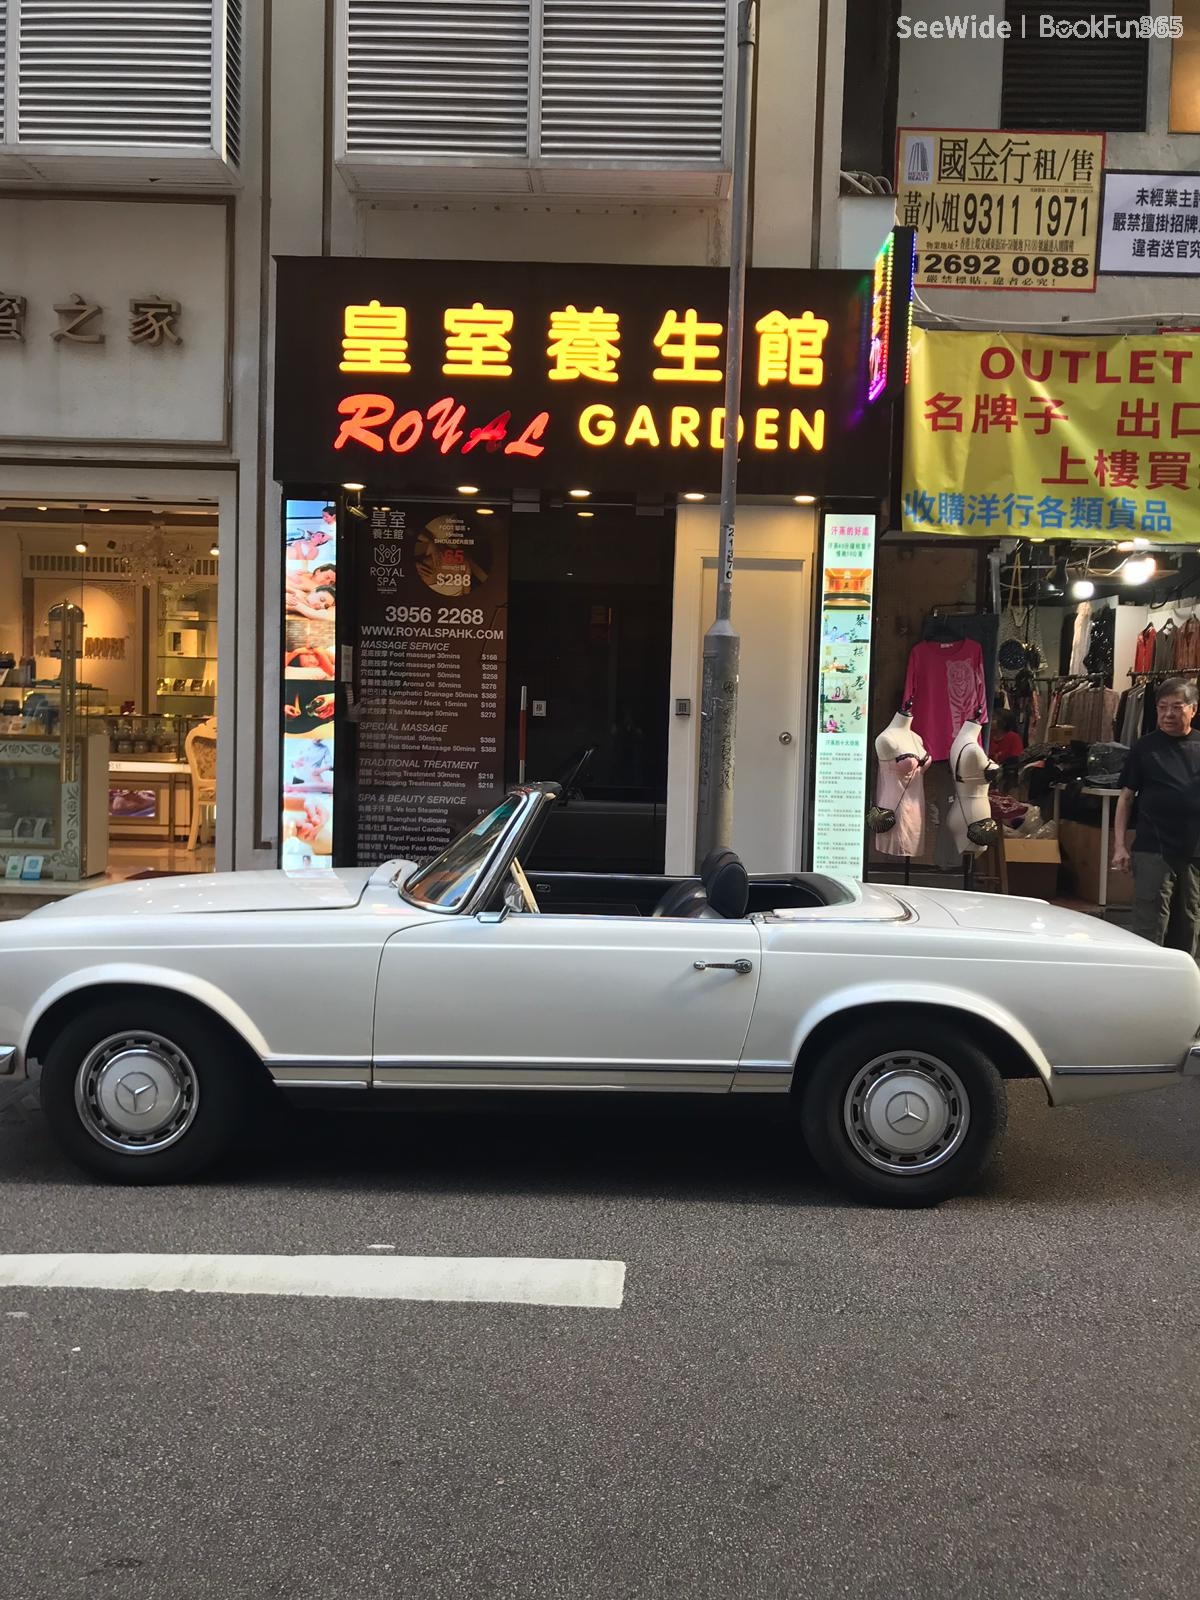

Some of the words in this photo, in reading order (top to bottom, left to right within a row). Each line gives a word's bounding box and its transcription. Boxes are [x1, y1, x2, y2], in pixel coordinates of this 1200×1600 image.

[903, 190, 960, 234] 黃小姐
[963, 192, 1020, 235] 9311
[1034, 195, 1089, 237] 1971
[1112, 212, 1200, 234] 嚴禁擅掛招牌
[1012, 256, 1089, 277] 0088
[338, 299, 830, 387] 皇室養生館
[980, 346, 1193, 384] OUTLET
[924, 392, 1069, 435] 名牌子
[578, 403, 826, 452] GARDEN
[1041, 446, 1200, 491] 上樓買
[904, 489, 1172, 532] 收購洋行各類貨品
[370, 510, 406, 528] 皇室
[369, 567, 405, 577] ROYAL
[377, 577, 397, 587] SPA
[436, 573, 471, 587] $288
[385, 606, 432, 623] 3956
[437, 608, 484, 625] 2268
[361, 626, 504, 640] WWW.ROYALSPAHK.COM
[360, 641, 408, 650] MASSAGE
[410, 642, 450, 651] SERVICE
[406, 652, 436, 660] massage
[437, 652, 460, 660] 30mins
[406, 662, 436, 670] massage
[389, 670, 430, 678] Acupressure
[402, 680, 424, 688] Aroma
[404, 709, 434, 717] Massage
[360, 722, 399, 731] SPECIAL
[400, 723, 449, 732] MASSAGE
[359, 758, 420, 768] TRADITIONAL
[423, 760, 479, 770] TREATMENT
[403, 770, 436, 778] Treatment
[408, 780, 442, 788] Treatment
[358, 793, 377, 802] SPA
[387, 794, 426, 803] BEAUTY
[427, 796, 467, 805] SERVICE
